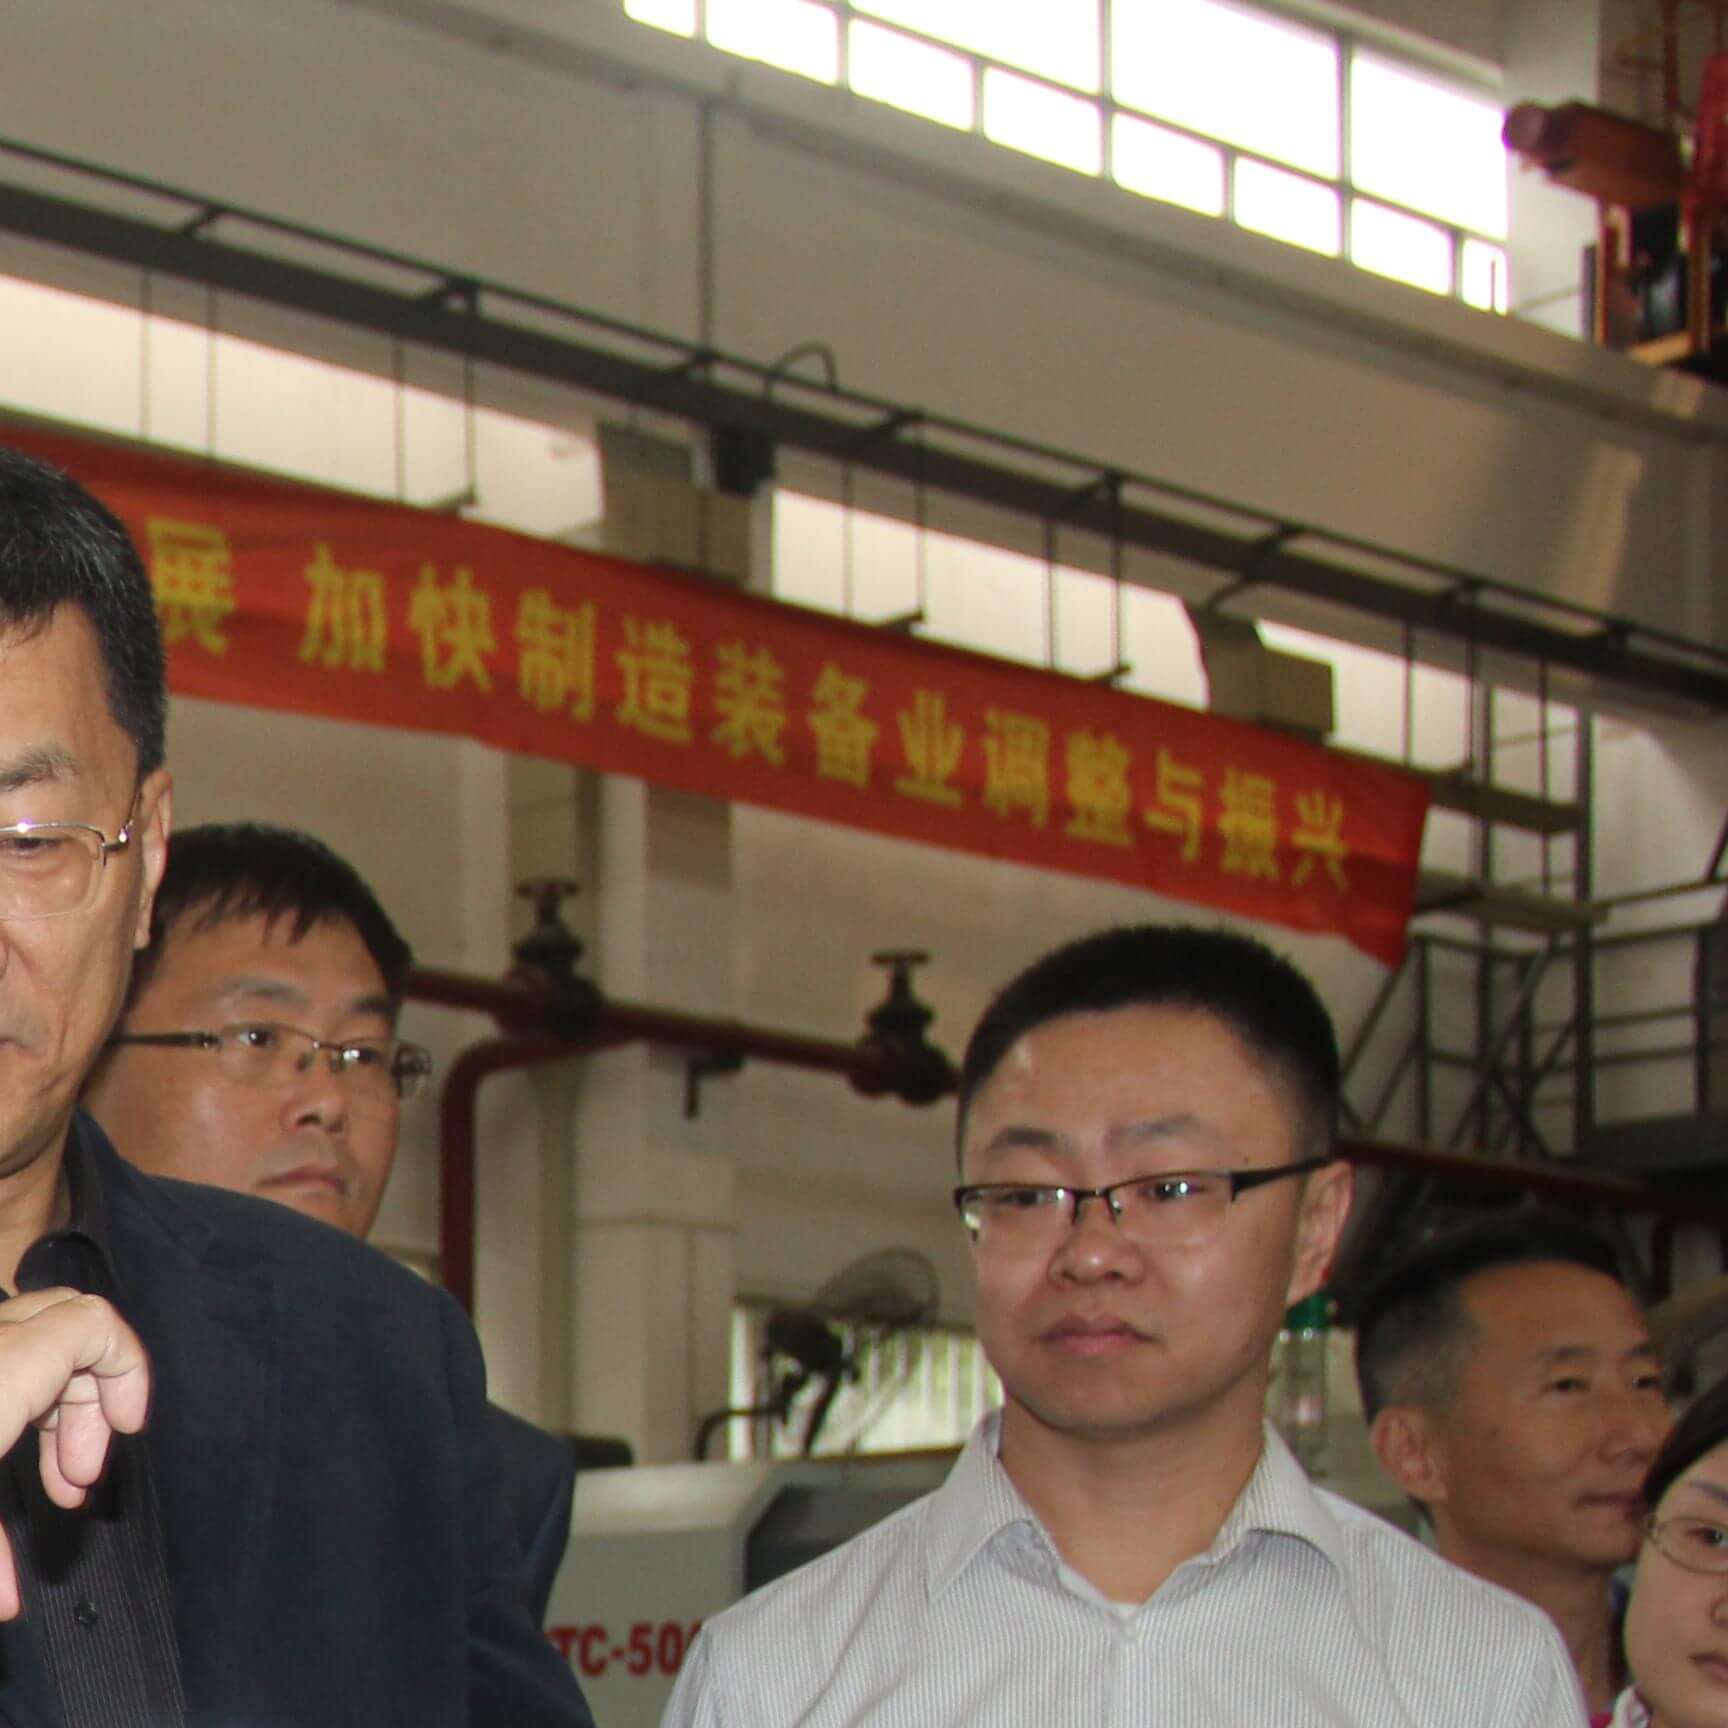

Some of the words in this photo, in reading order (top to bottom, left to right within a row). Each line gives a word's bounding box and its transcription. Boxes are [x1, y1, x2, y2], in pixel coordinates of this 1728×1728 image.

[298, 540, 1349, 892] 加快制造装备业调整与振兴
[545, 1620, 702, 1678] TC-50
